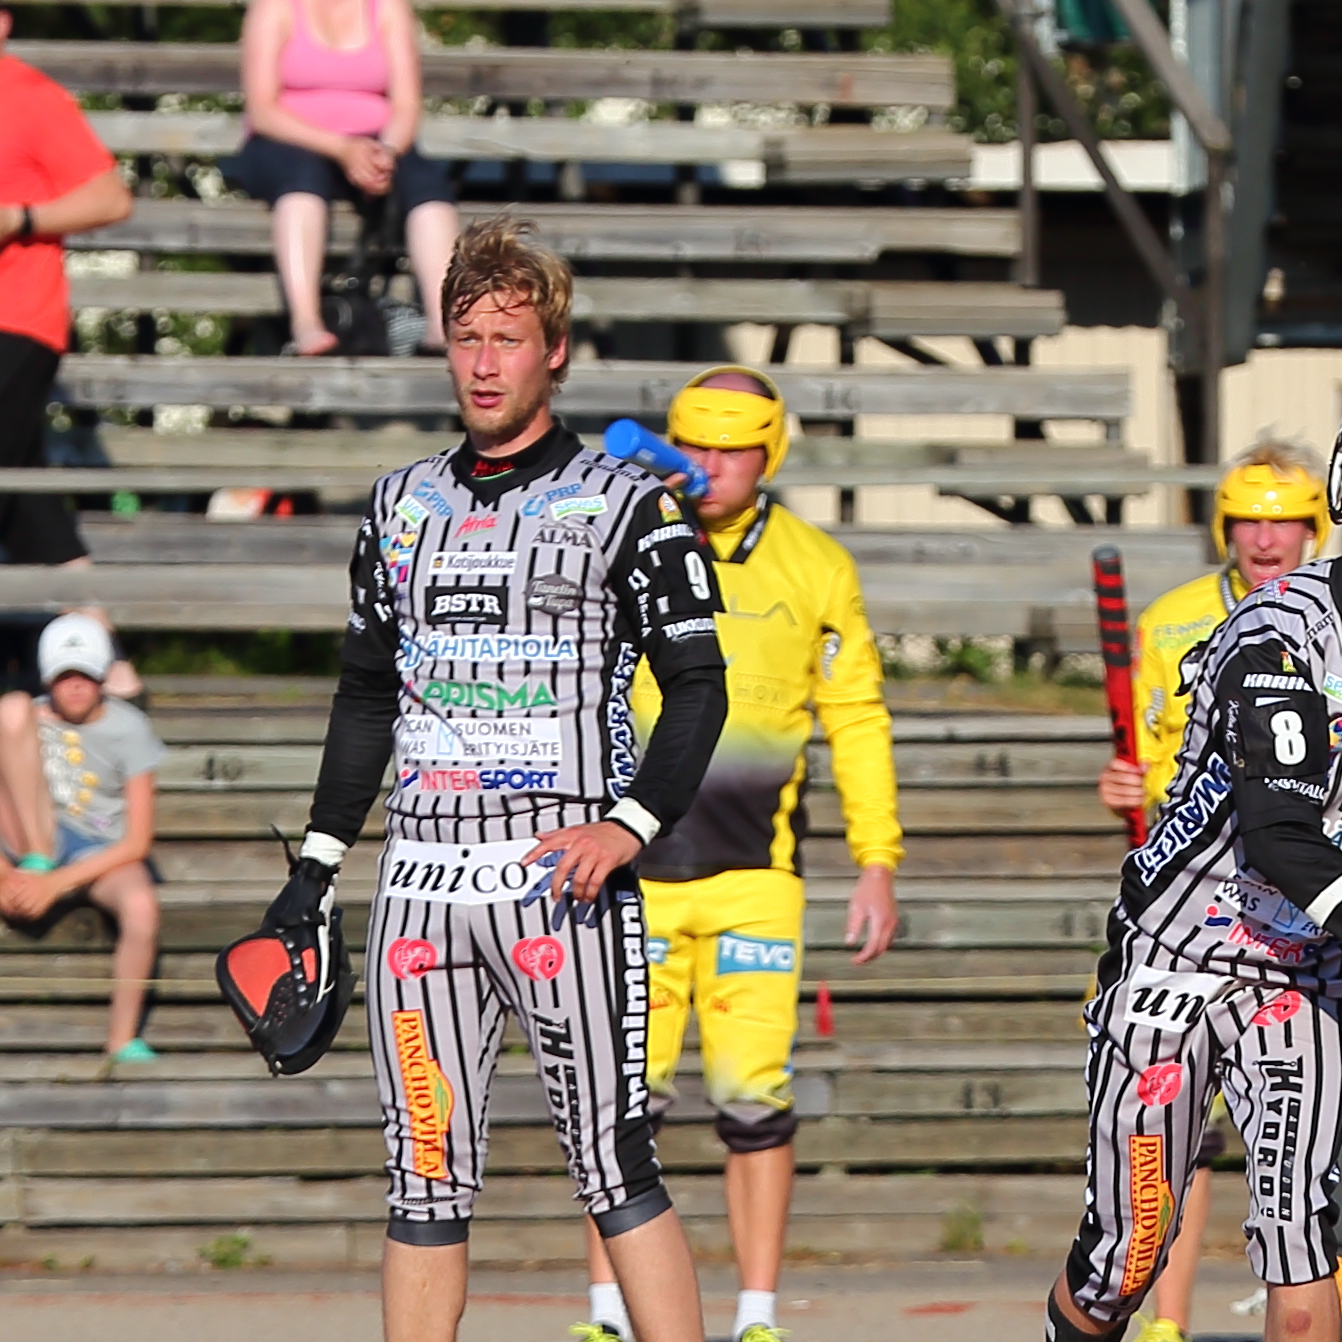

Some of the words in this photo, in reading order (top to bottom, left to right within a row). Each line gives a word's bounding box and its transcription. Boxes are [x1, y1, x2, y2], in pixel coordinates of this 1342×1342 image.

[427, 491, 453, 516] PRP
[545, 483, 582, 500] PRP
[533, 529, 591, 549] ALMA
[447, 554, 517, 571] Kotijoukkue
[684, 550, 711, 600] 9
[431, 594, 502, 616] BSTR
[419, 632, 575, 660] ÄHITAPIOLA
[422, 681, 557, 711] PRISMA
[456, 722, 532, 738] SUOMEN
[1269, 710, 1307, 766] 8
[420, 768, 559, 791] INTERSPORT
[389, 847, 529, 893] unico
[1221, 879, 1260, 912] WAS
[717, 934, 792, 967] TEVO
[621, 897, 649, 1121] miniman
[401, 1015, 431, 1110] PANCHO
[1257, 1055, 1304, 1197] HYDRO
[1279, 1101, 1300, 1220] LAKEUDEN
[1138, 1138, 1159, 1227] PANCHO
